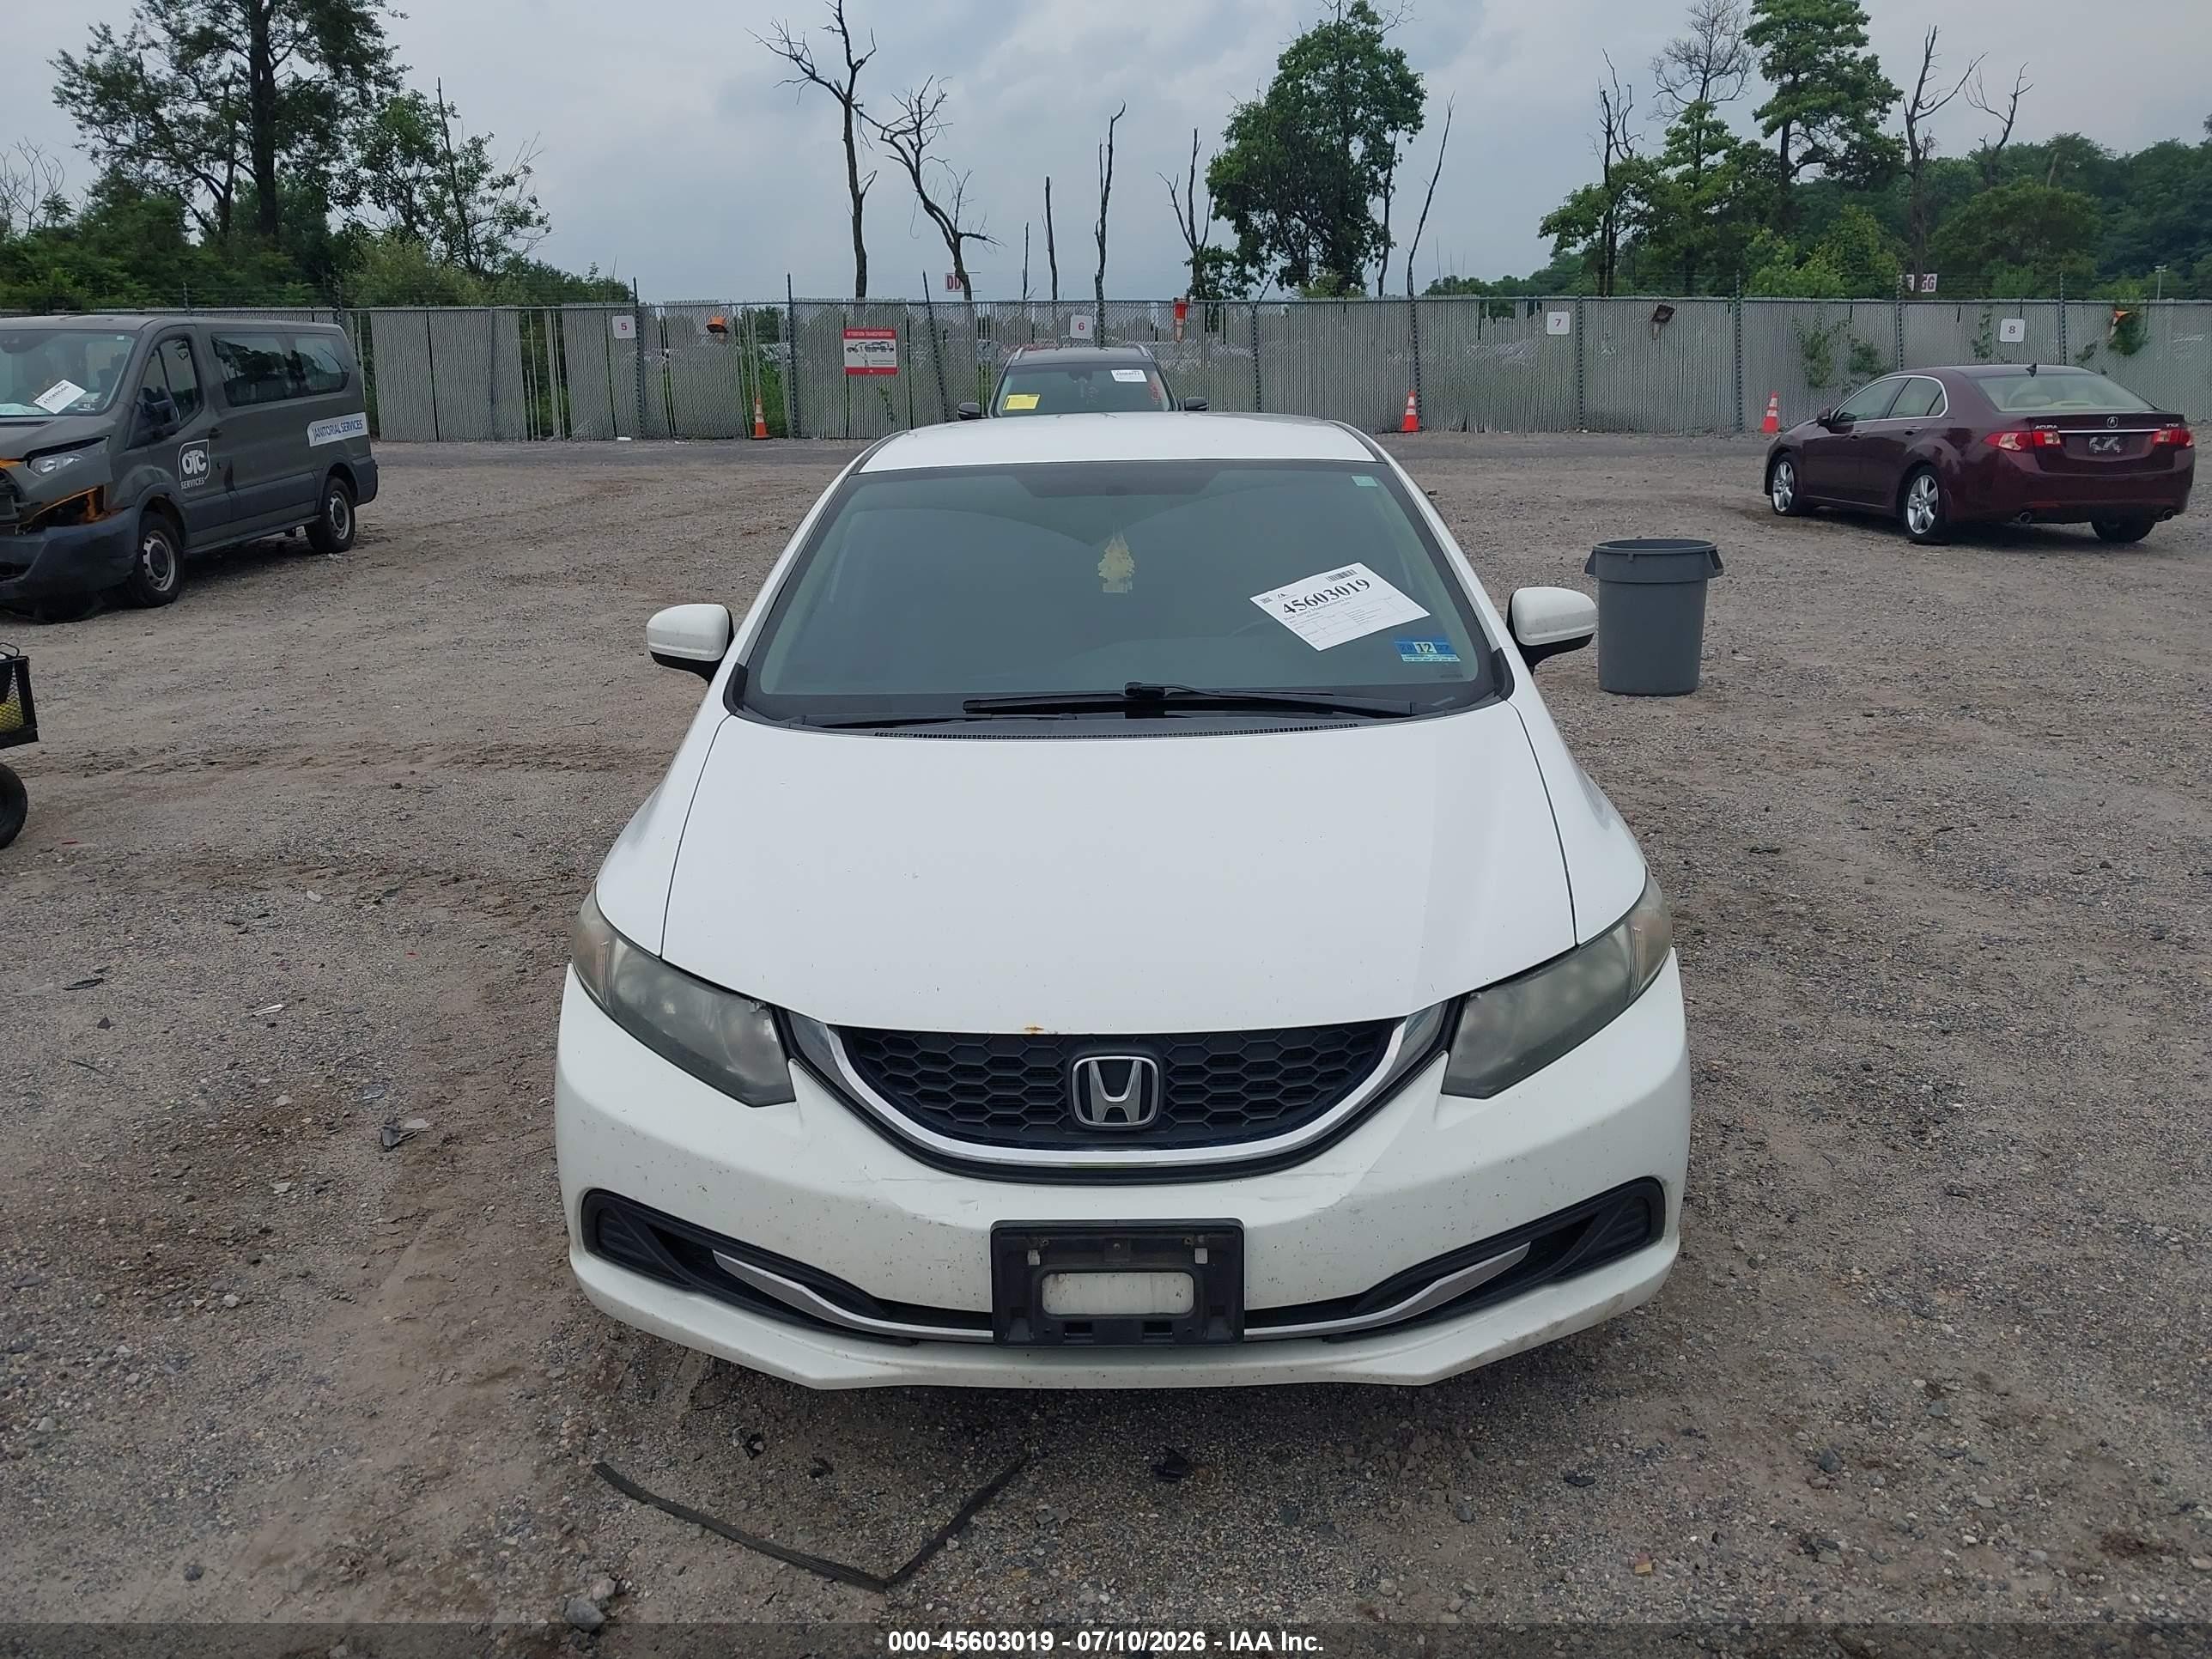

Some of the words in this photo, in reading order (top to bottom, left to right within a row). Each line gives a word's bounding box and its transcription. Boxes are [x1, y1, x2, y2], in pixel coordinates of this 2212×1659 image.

[621, 322, 628, 331] 5
[1078, 322, 1085, 331] 6
[1555, 318, 1562, 326] 7
[2008, 325, 2016, 334] 8
[312, 422, 342, 442] JANITORIAL
[341, 419, 363, 433] SERVICES
[181, 449, 207, 474] OTC
[180, 477, 205, 489] SERVICES
[1283, 578, 1370, 613] 45603019
[1415, 643, 1434, 653] 12
